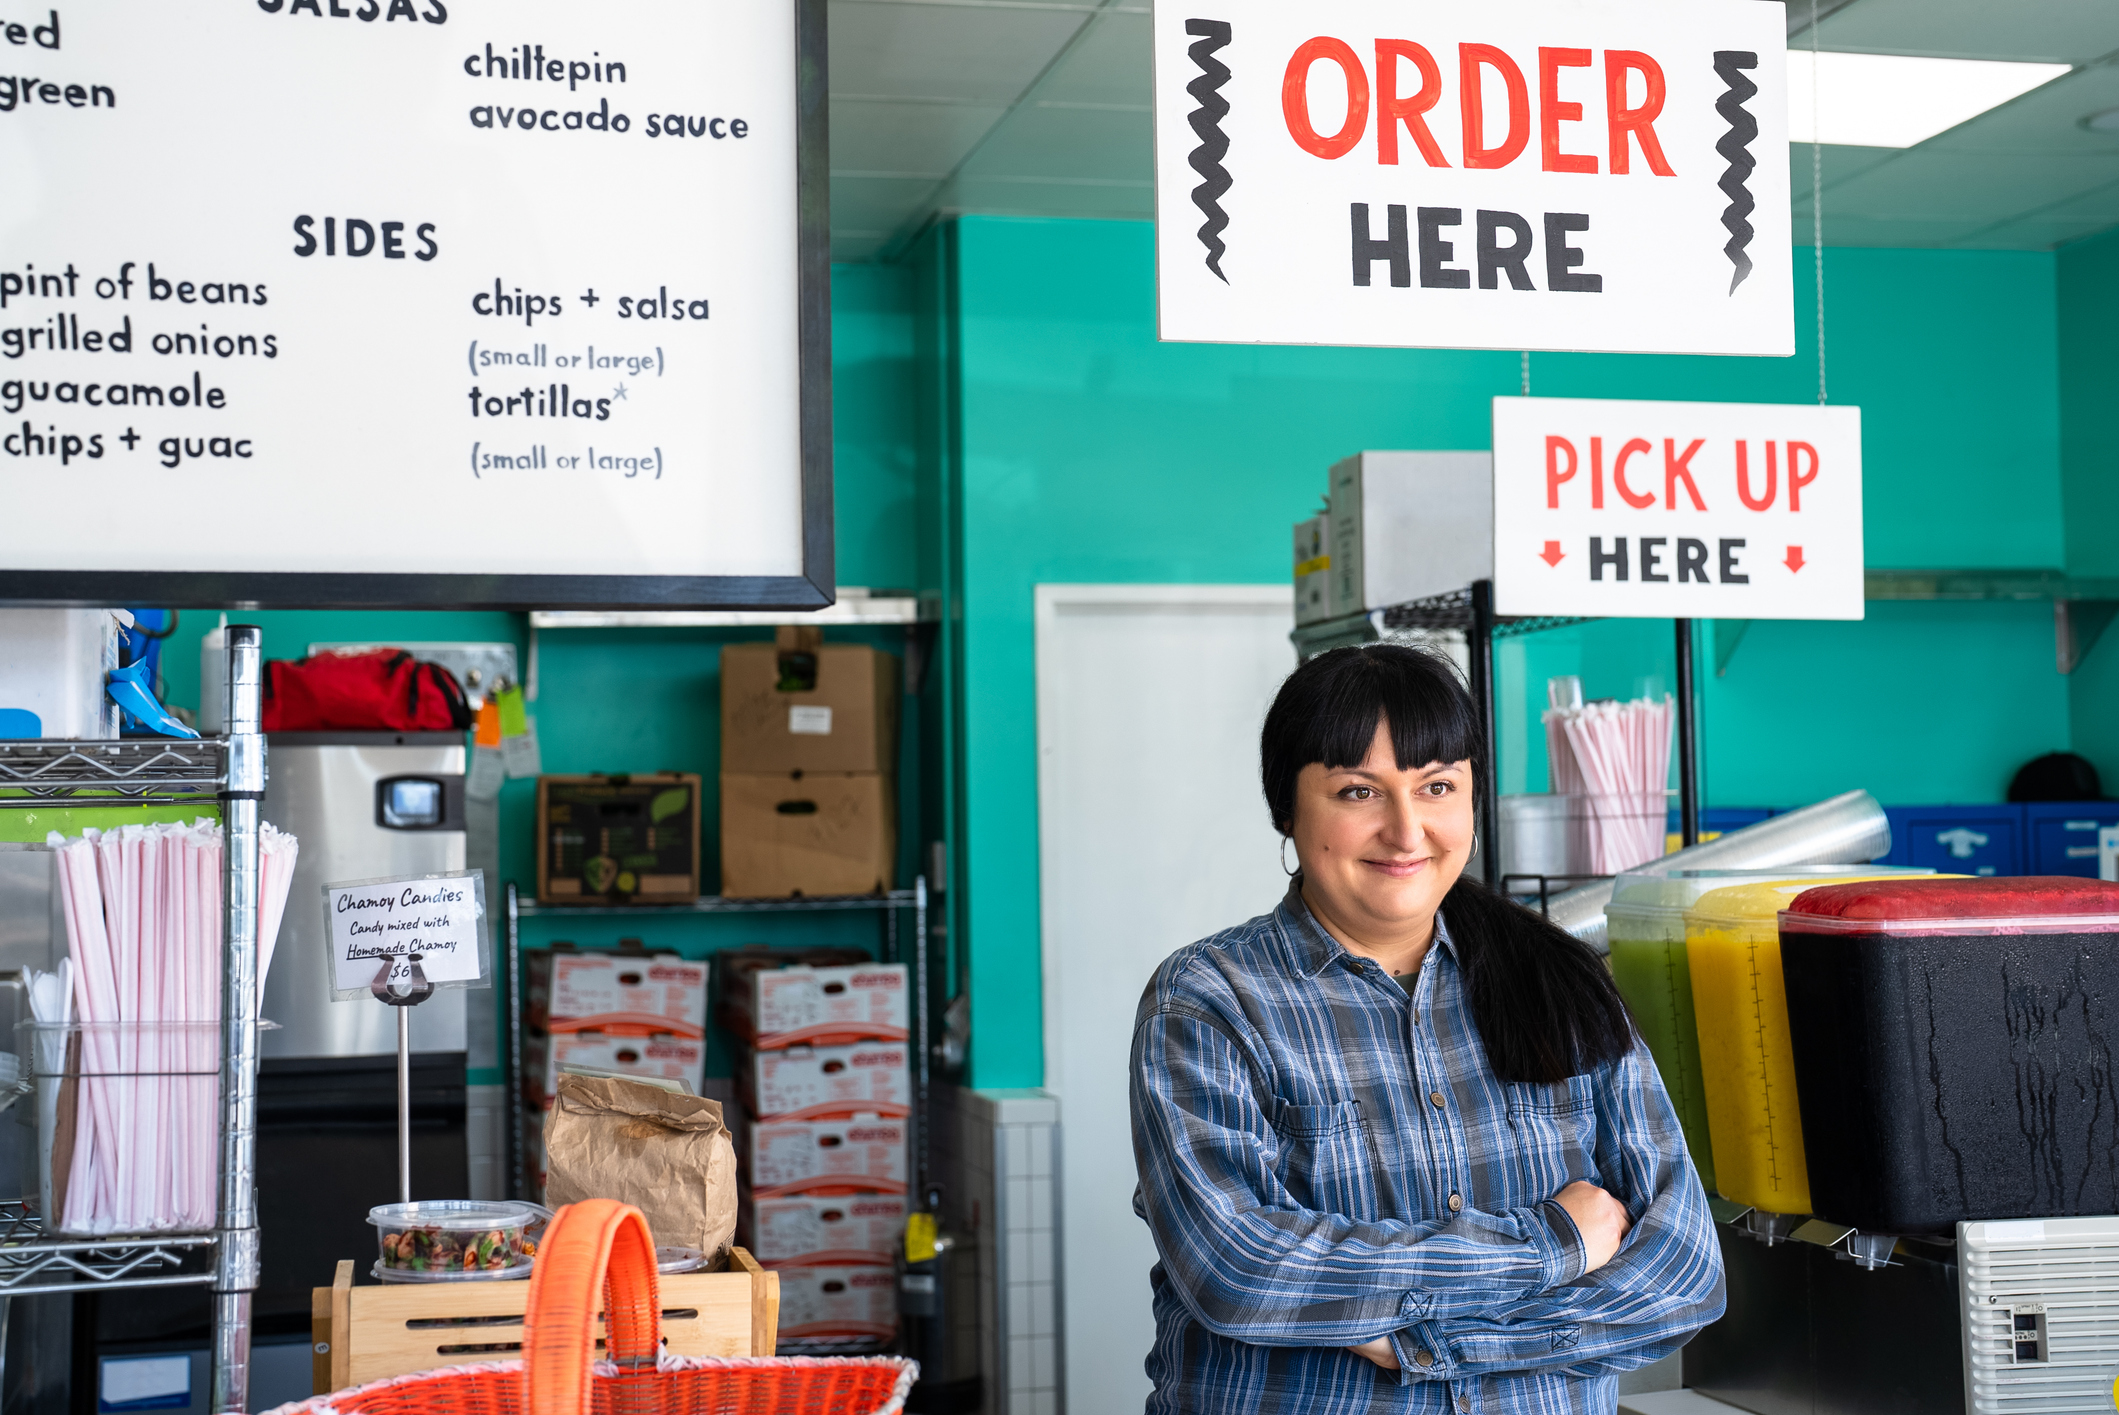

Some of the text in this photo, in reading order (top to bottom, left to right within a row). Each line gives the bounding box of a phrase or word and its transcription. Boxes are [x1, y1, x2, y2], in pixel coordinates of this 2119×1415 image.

[0, 9, 60, 50] ed
[463, 42, 627, 91] chiltepin
[0, 75, 115, 113] green
[1281, 35, 1679, 178] ORDER
[469, 98, 749, 140] avocado sauce
[292, 214, 439, 262] SIDES
[1350, 202, 1603, 294] HERE
[0, 262, 268, 309] pint of beans
[472, 277, 710, 327] chips + salsa
[1, 312, 278, 360] grilled onions
[468, 340, 665, 377] (small or large)
[1, 371, 227, 414] guacamole
[3, 421, 254, 469] chips + guac
[471, 442, 663, 480] (small or large)
[1545, 434, 1821, 513] PICK UP
[1589, 536, 1750, 585] HERE
[337, 887, 463, 913] Chamoy Candies
[347, 938, 457, 957] Homemade Chamoy
[350, 915, 450, 936] Candy mixed with
